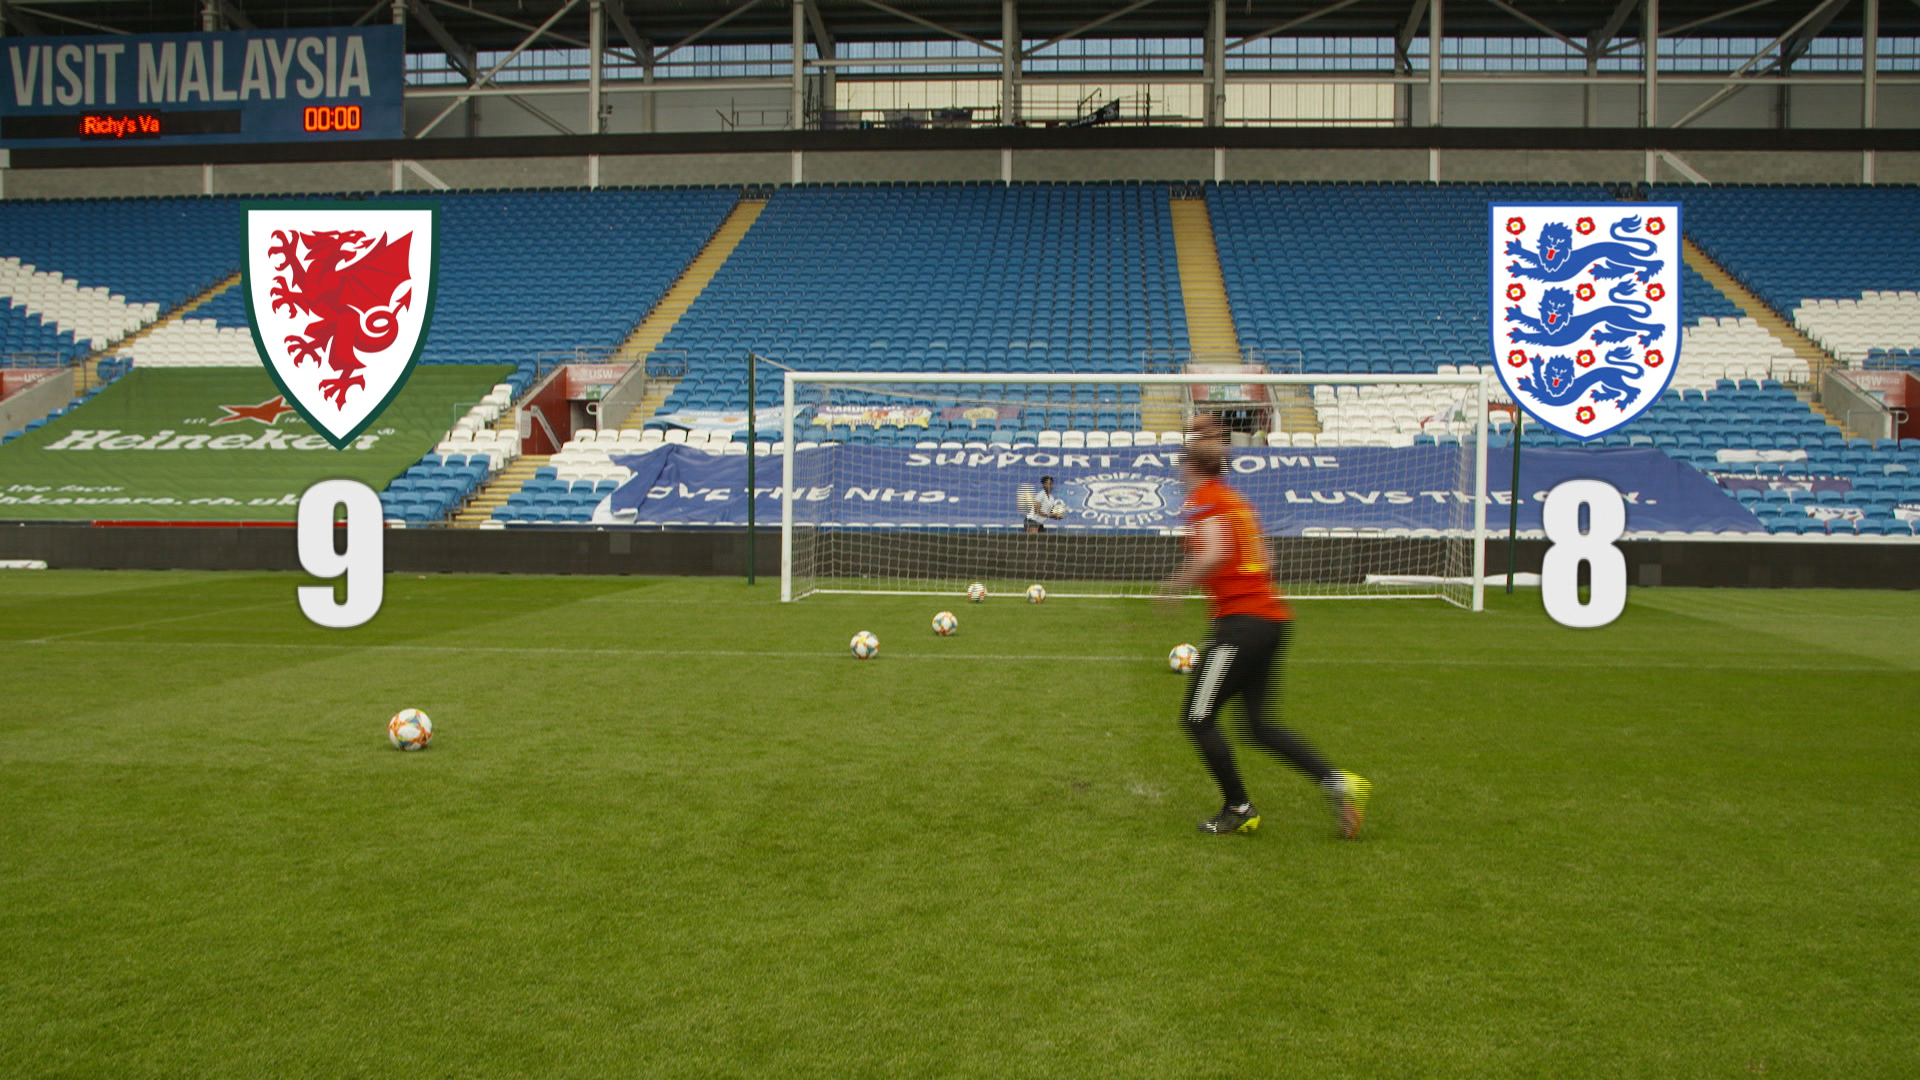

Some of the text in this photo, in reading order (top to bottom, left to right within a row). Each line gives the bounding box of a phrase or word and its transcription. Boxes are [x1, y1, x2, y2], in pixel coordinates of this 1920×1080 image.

[9, 34, 371, 106] VISIT MALAYSIA
[304, 105, 361, 131] 00:00
[43, 429, 380, 451] Heineken
[905, 453, 1339, 473] SUPPORT AT OME
[646, 482, 730, 501] OVE
[843, 487, 959, 503] NHS.
[1285, 489, 1414, 504] LUVS
